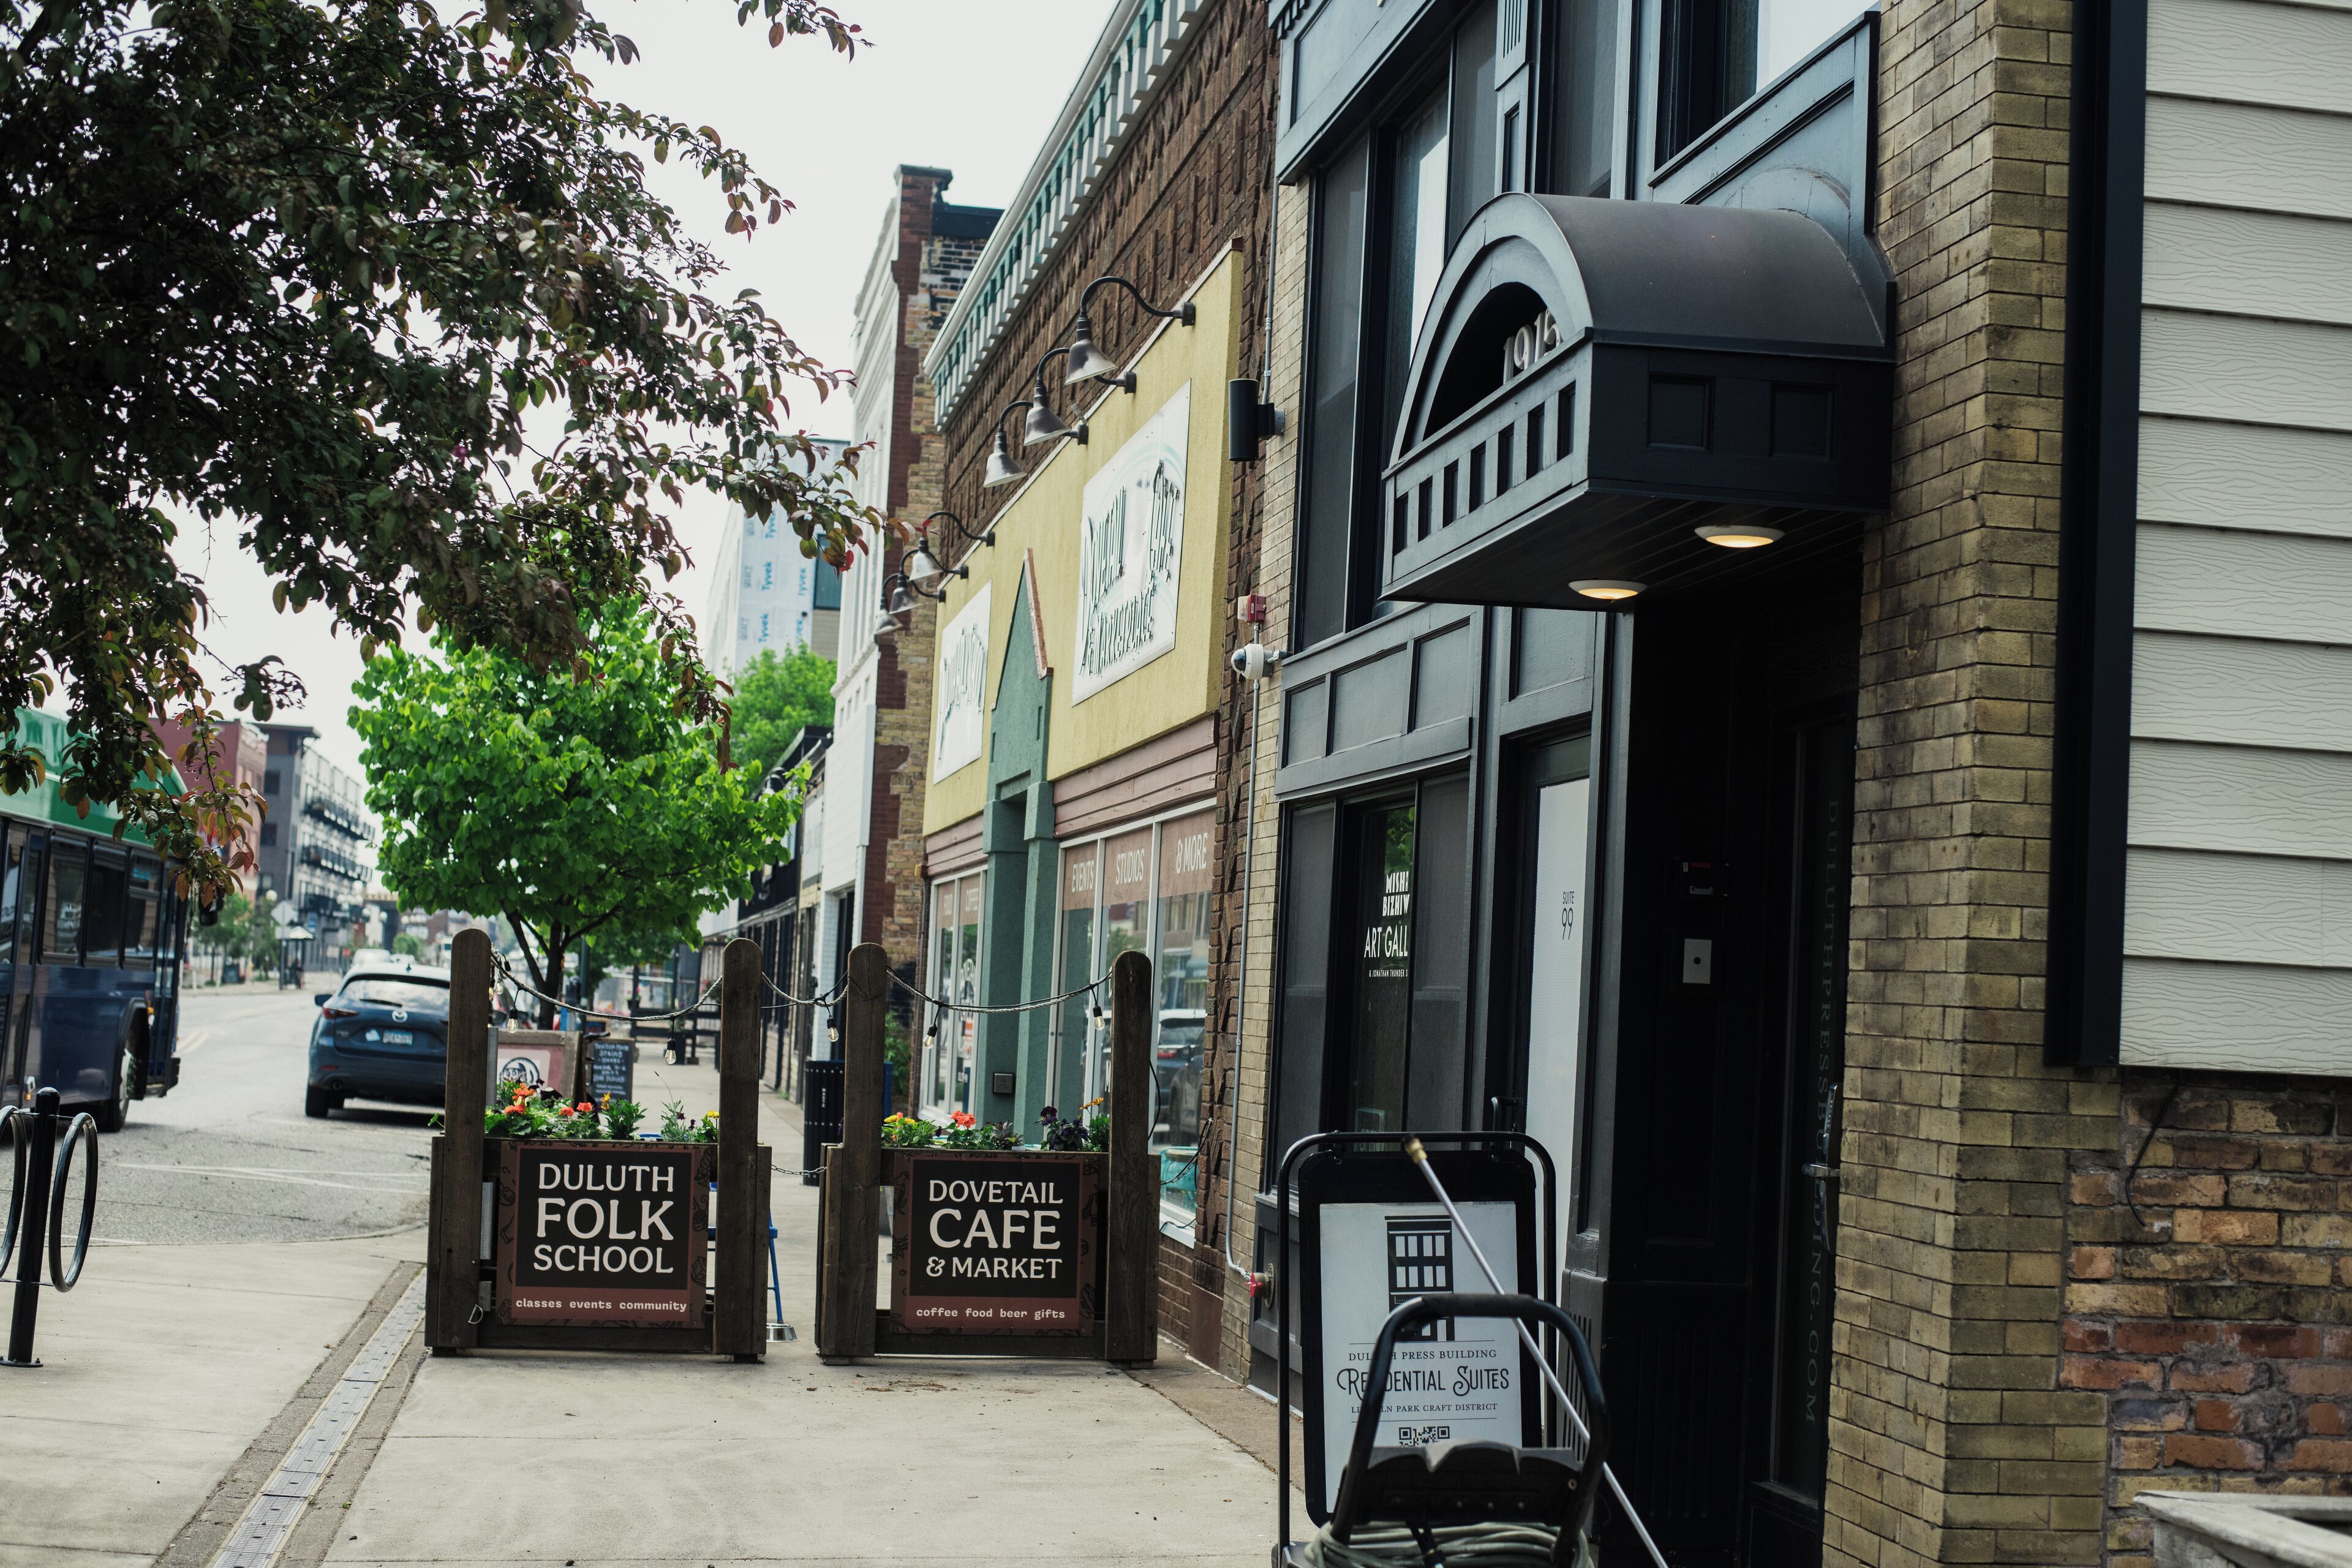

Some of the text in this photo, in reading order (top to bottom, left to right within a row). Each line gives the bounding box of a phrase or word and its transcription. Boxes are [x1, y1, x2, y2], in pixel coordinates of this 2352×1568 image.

[1503, 308, 1563, 385] 1915
[762, 561, 773, 591] Tyvek
[798, 567, 808, 595] Tyvek
[1080, 484, 1126, 675] DOVETAIL
[758, 613, 770, 643] Tyvek
[1095, 578, 1156, 675] MARKETPLACE
[1072, 832, 1208, 893] EVENTS STUDIOS & MORE
[1382, 894, 1410, 917] BIZHIW
[1562, 891, 1575, 905] SUITE
[1562, 907, 1574, 940] 99
[1364, 924, 1408, 958] ART GALL
[538, 1163, 674, 1193] DULUTH
[929, 1180, 1063, 1204] DOVETAIL
[537, 1197, 674, 1240] FOLK
[929, 1208, 1061, 1250] CAFE
[533, 1245, 674, 1273] SCHOOL
[926, 1256, 1063, 1279] & MARKET
[516, 1298, 687, 1313] classes events community
[916, 1308, 1065, 1320] coffee food beer gifts
[1349, 1349, 1497, 1360] DULH PRESS BUILDING
[1337, 1365, 1509, 1401] REDENTIAL SUITES
